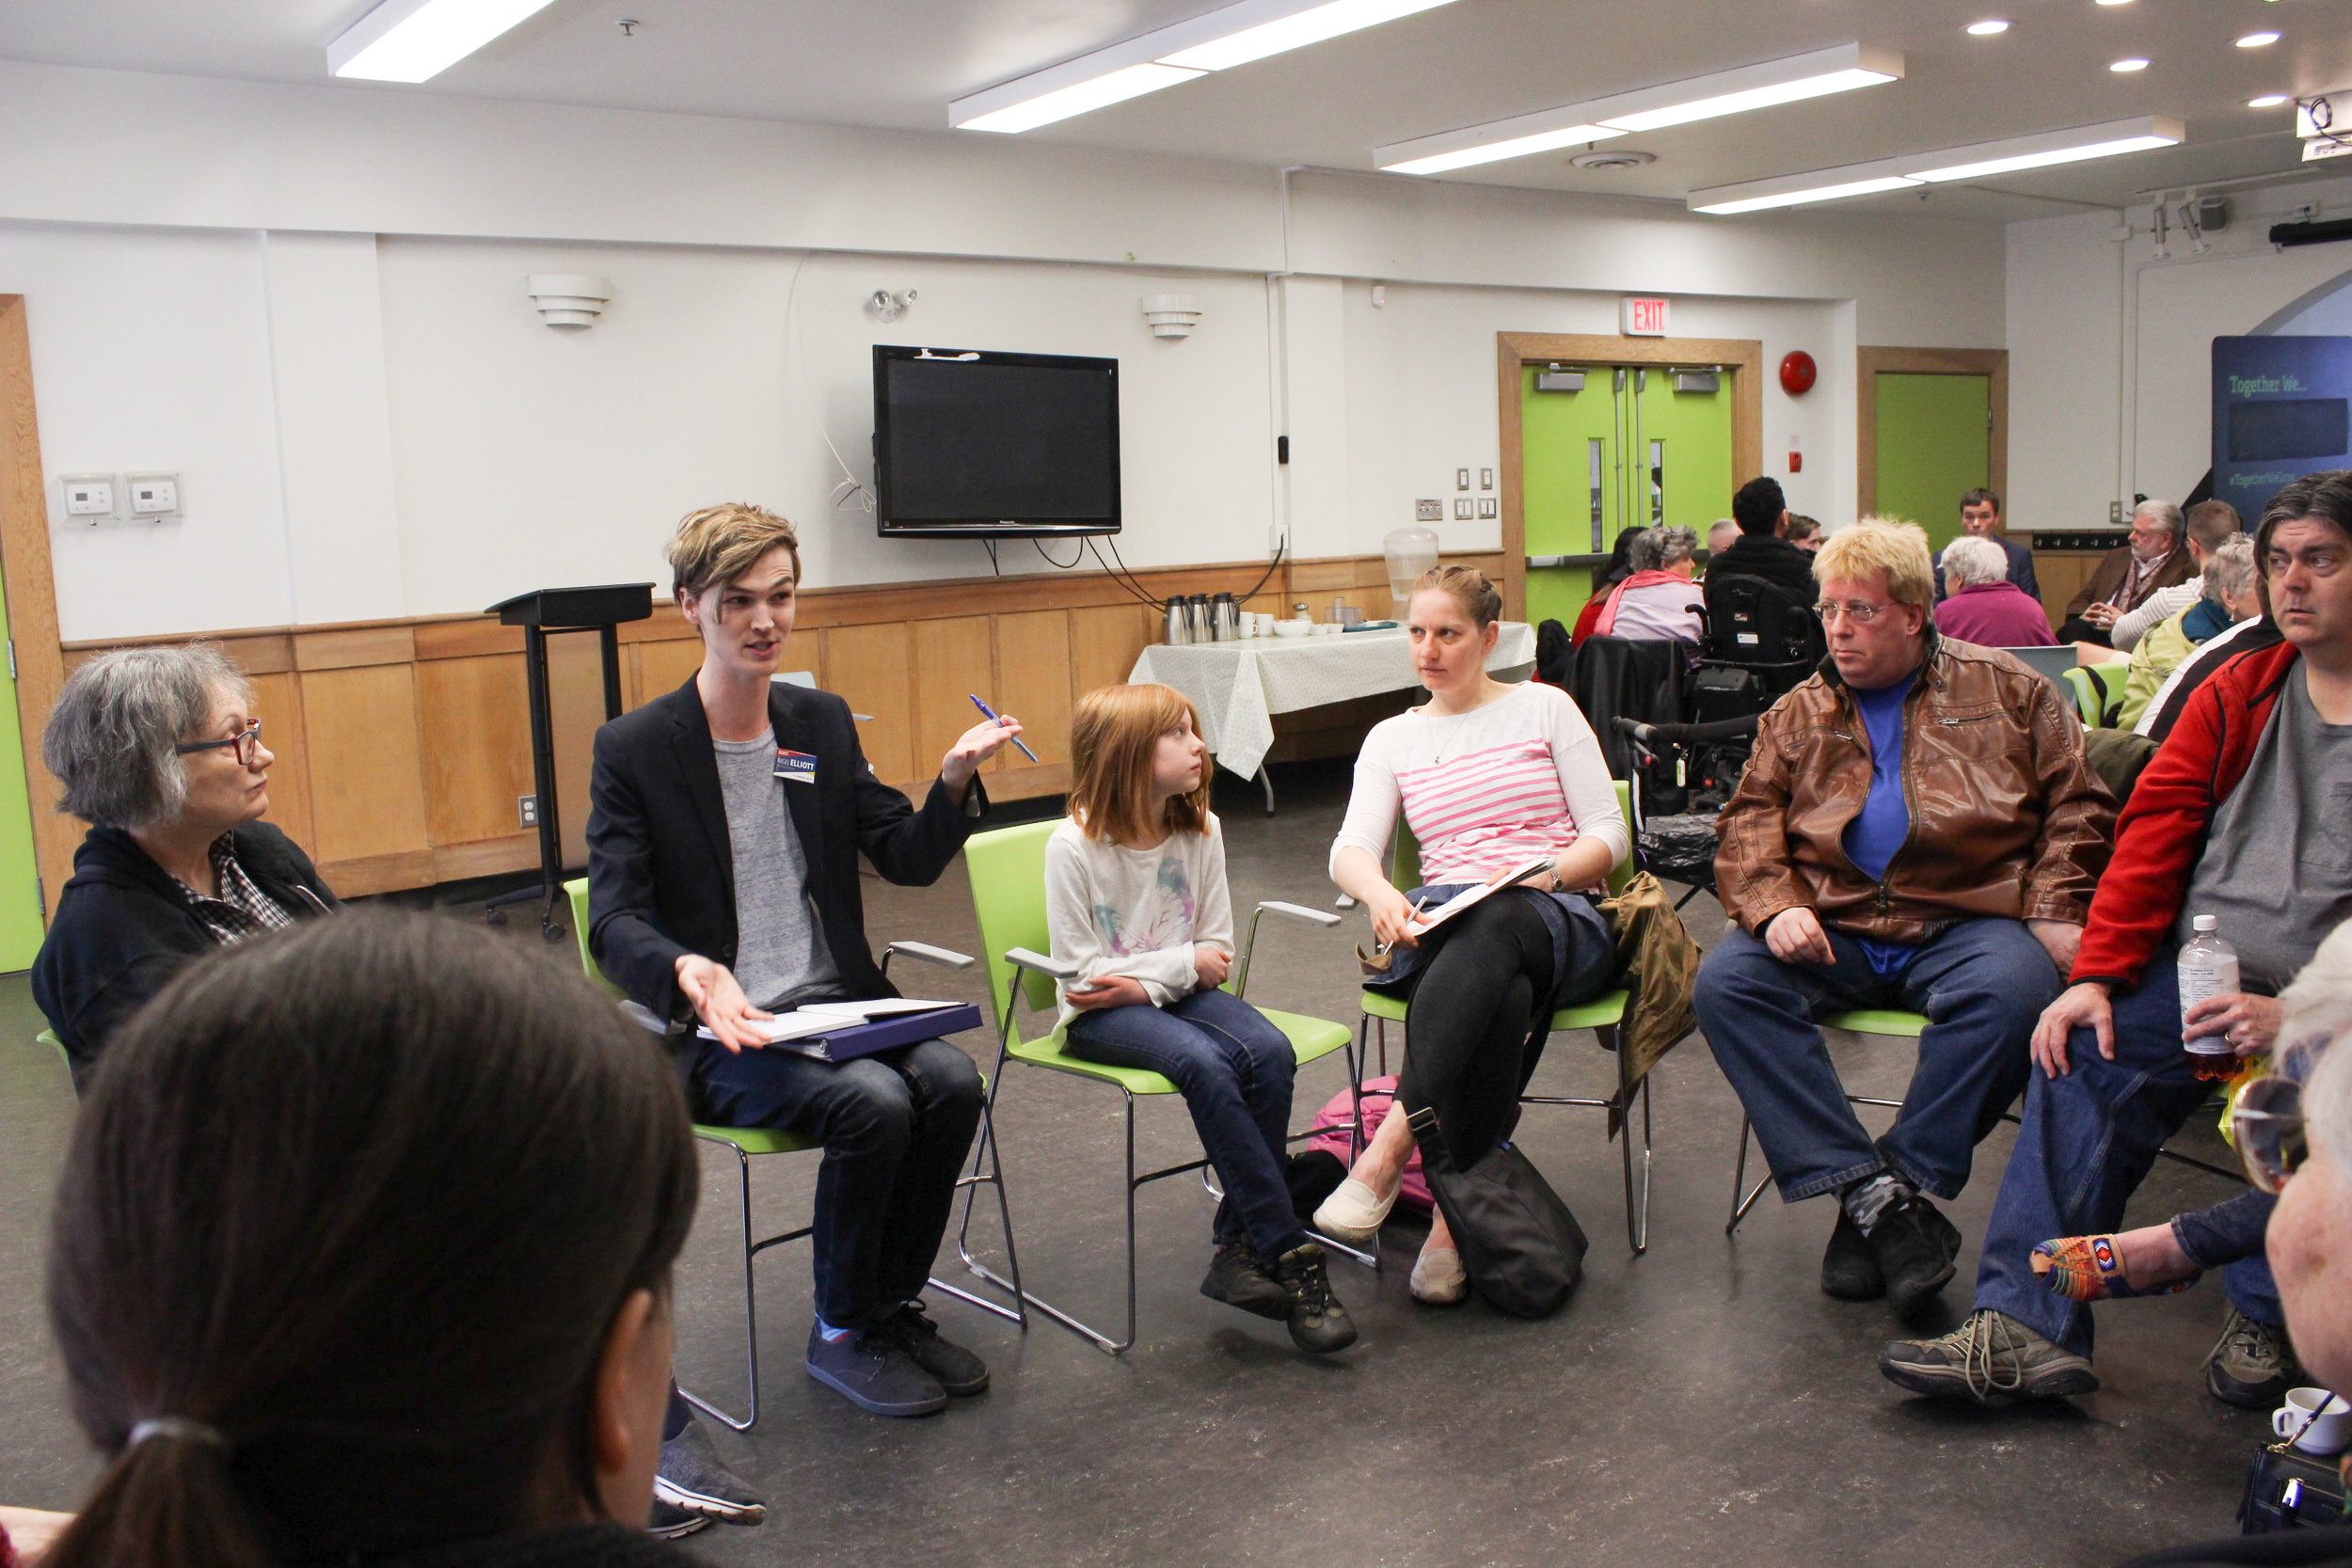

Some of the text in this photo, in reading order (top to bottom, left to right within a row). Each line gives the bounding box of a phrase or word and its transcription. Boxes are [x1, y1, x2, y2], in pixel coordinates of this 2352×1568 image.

[1633, 299, 1664, 331] EXIT
[2230, 374, 2279, 397] Together
[790, 759, 814, 769] ELLIOTT
